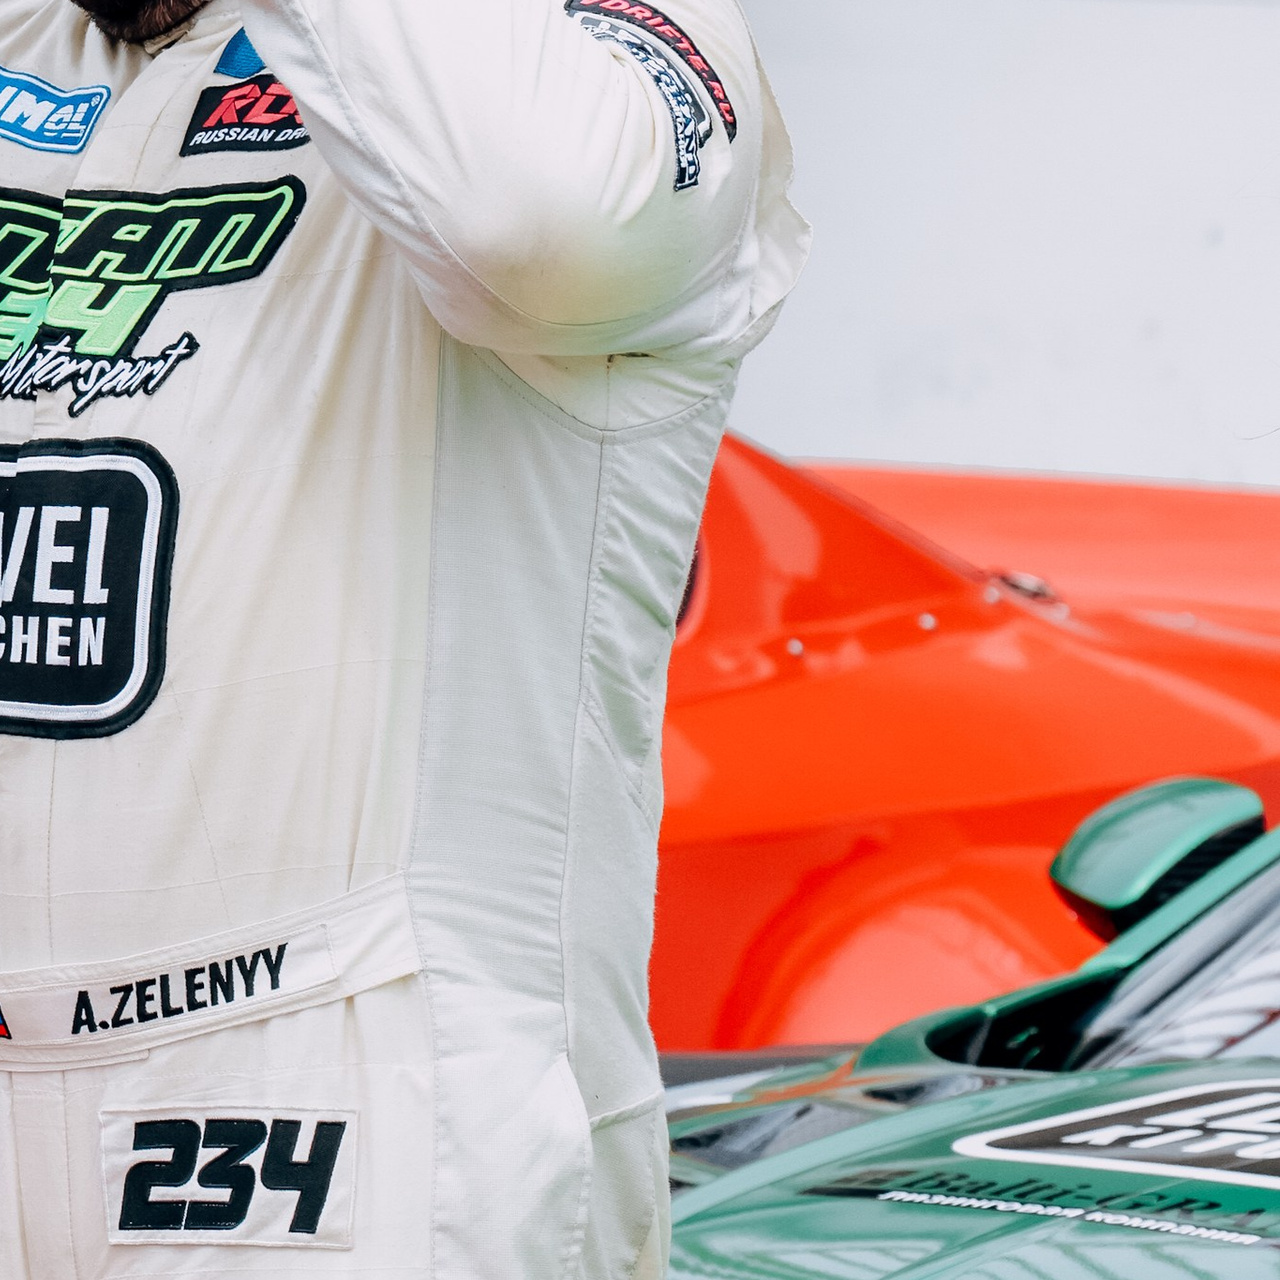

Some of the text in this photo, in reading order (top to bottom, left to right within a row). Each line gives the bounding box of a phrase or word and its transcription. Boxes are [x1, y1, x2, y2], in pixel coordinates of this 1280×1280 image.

[188, 127, 277, 147] RUSSIAN
[202, 83, 304, 128] RD
[71, 942, 289, 1035] A.ZELENYY
[118, 1118, 348, 1234] 234
